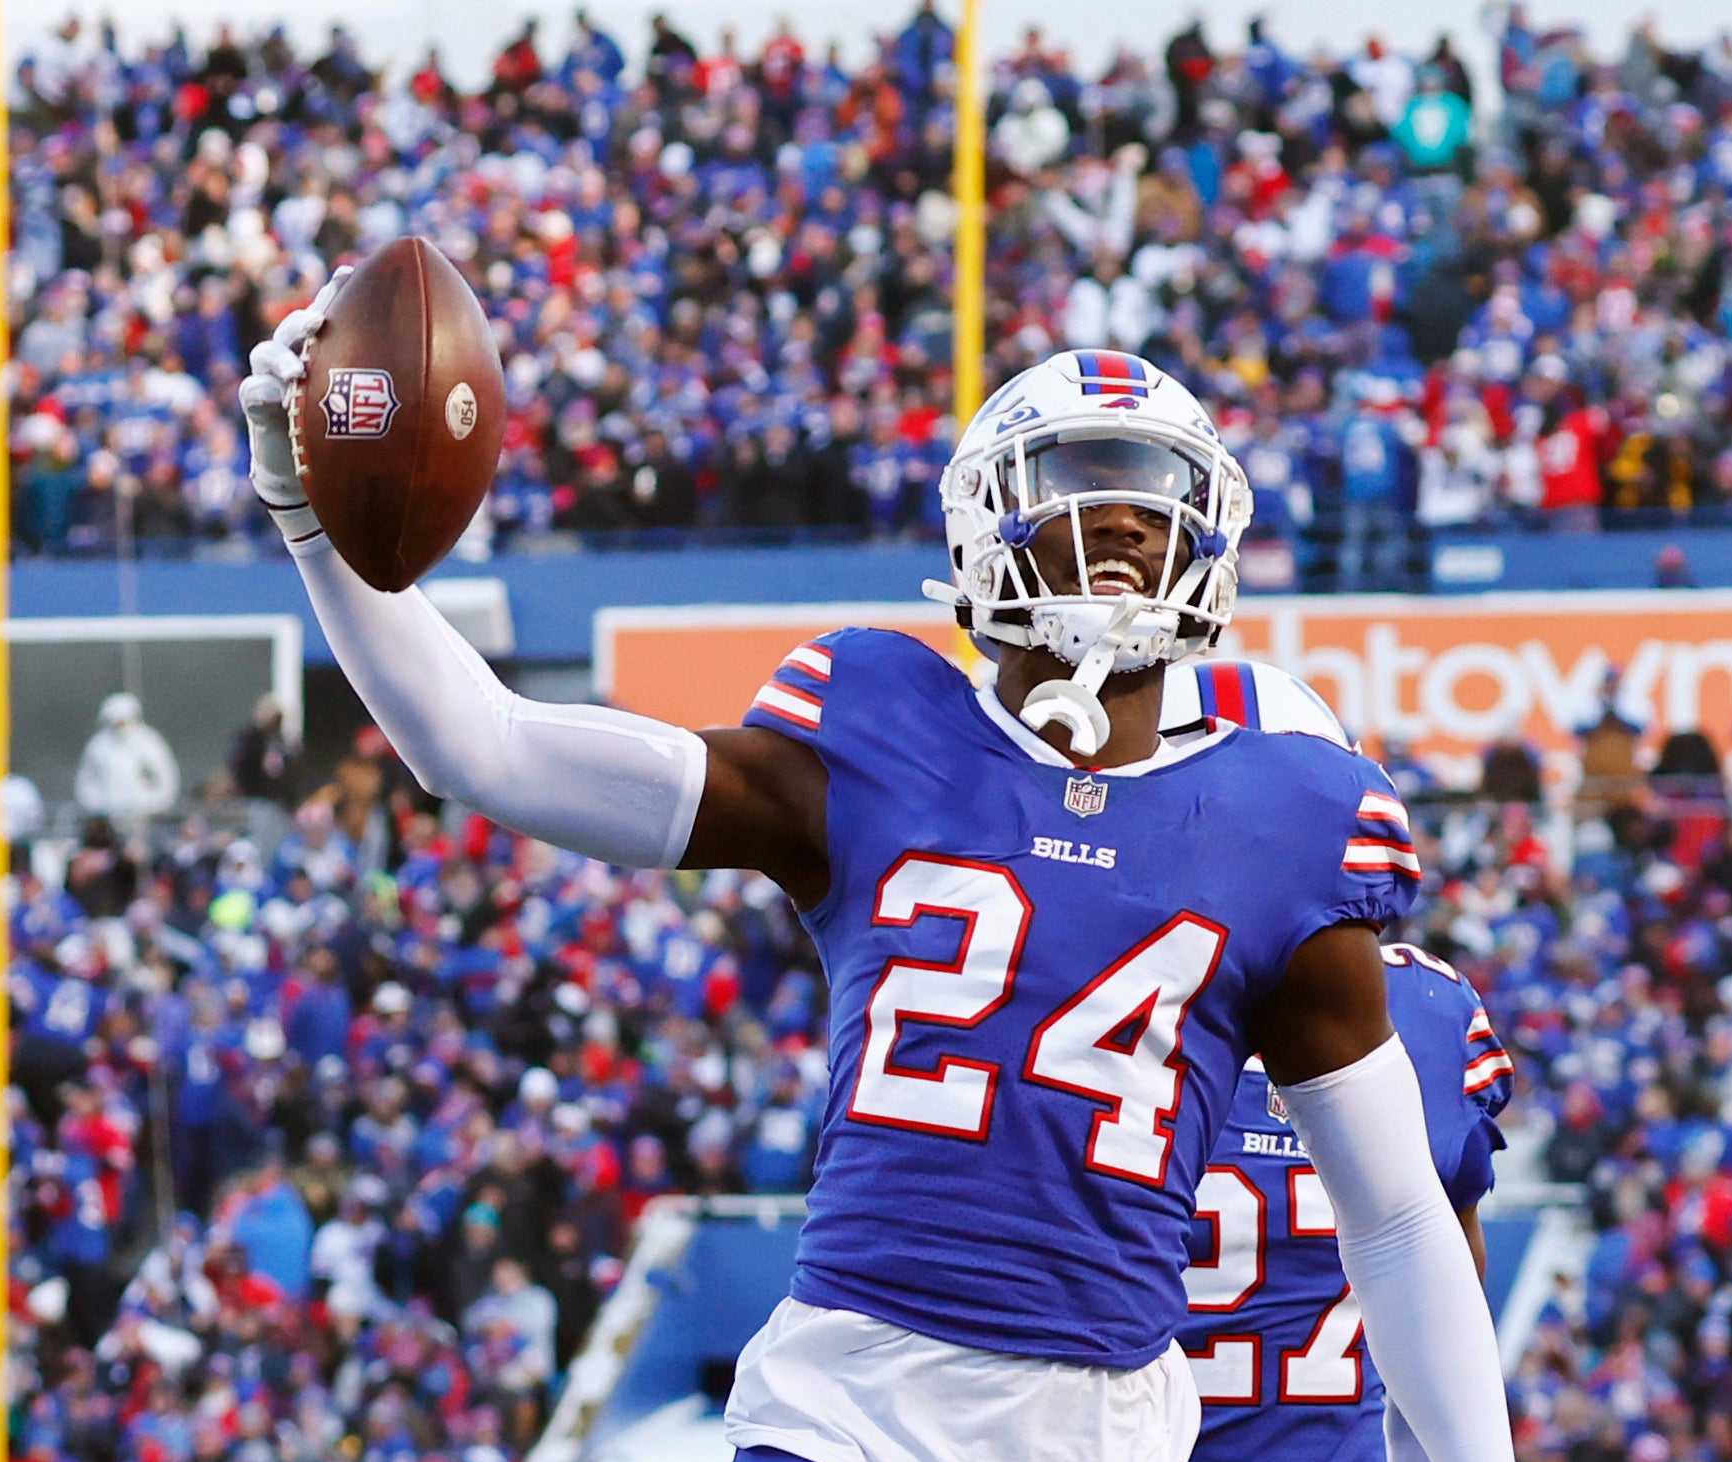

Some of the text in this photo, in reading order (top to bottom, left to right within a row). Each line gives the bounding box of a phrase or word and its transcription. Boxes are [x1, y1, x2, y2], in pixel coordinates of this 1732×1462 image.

[1030, 836, 1117, 870] BILLS
[846, 849, 1230, 1189] 24
[1186, 1164, 1364, 1407] 27
